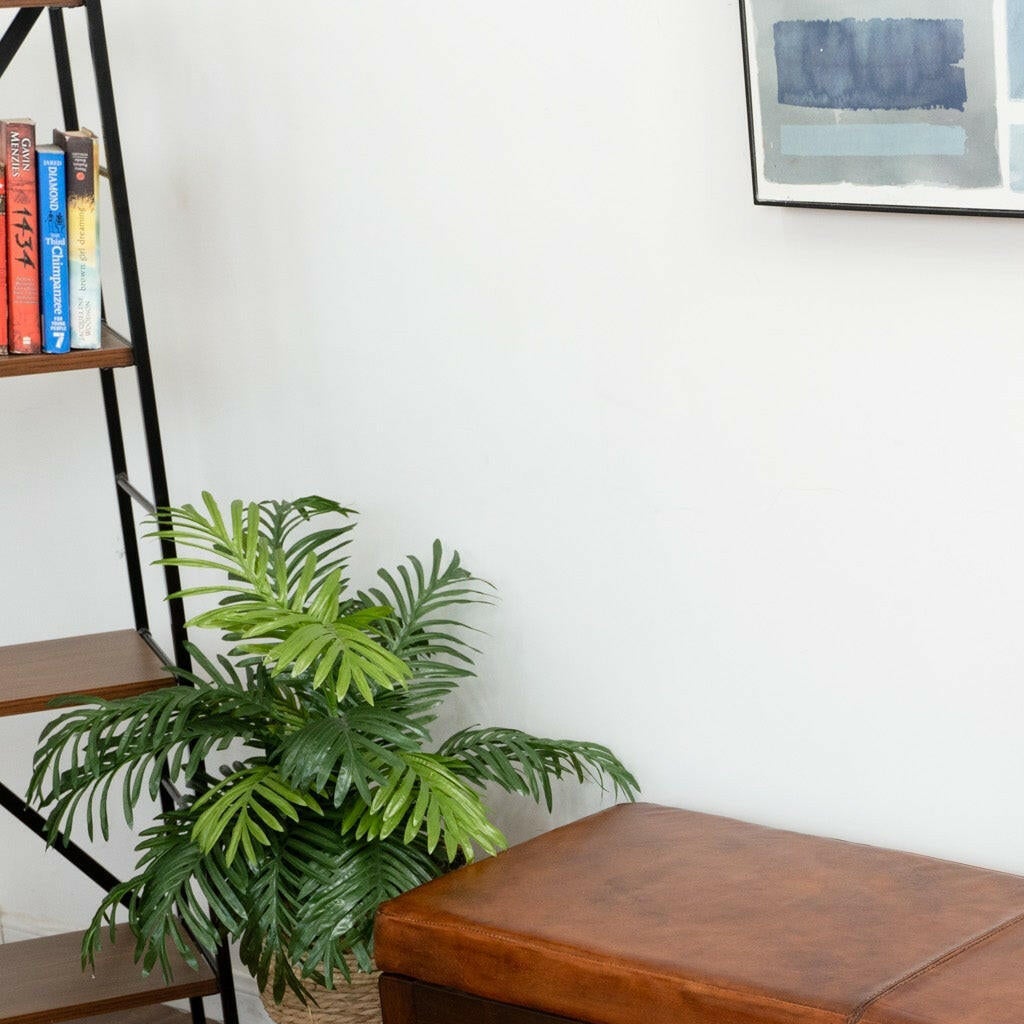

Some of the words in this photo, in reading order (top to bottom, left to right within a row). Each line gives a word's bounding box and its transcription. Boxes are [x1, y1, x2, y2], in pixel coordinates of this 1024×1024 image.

[10, 131, 20, 177] MENZIES
[21, 137, 32, 171] GAVIN
[48, 166, 59, 211] DIAMOND
[12, 207, 36, 269] 1434
[45, 237, 66, 246] Third
[78, 207, 86, 245] dreaming
[79, 248, 87, 261] girl
[50, 246, 63, 315] Chimpanzee
[79, 264, 87, 292] brown
